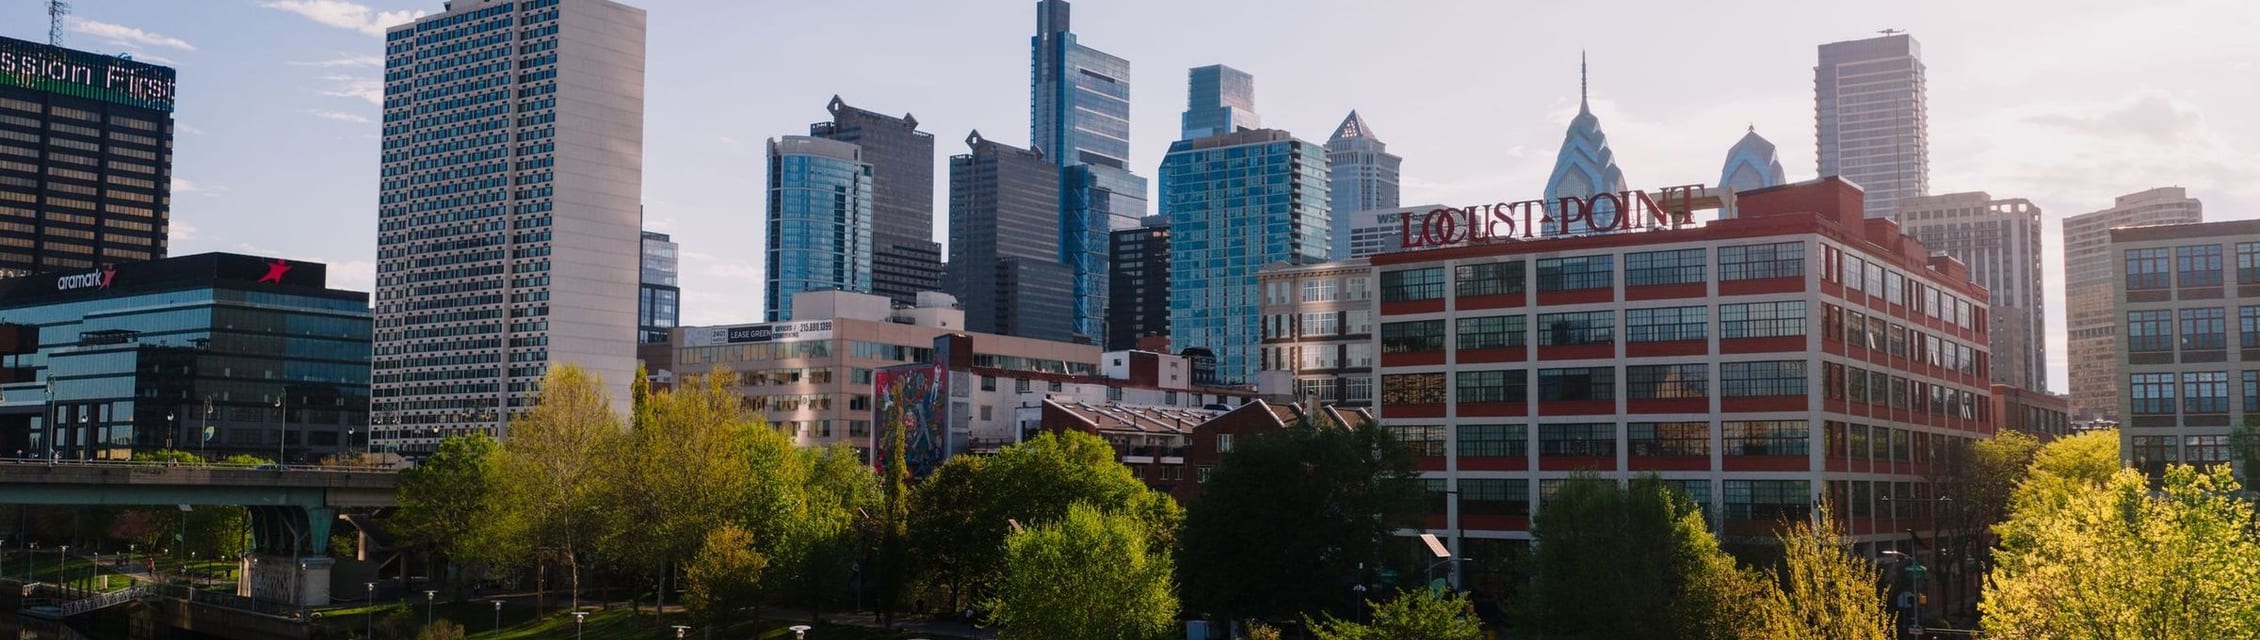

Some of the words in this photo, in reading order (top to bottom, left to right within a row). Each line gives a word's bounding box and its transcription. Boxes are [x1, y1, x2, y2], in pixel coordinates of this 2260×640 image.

[1400, 199, 1544, 249] LOCUST
[1557, 184, 1704, 235] POINT
[58, 268, 102, 290] aramark
[731, 330, 750, 339] LEASE
[751, 329, 771, 338] GREEN
